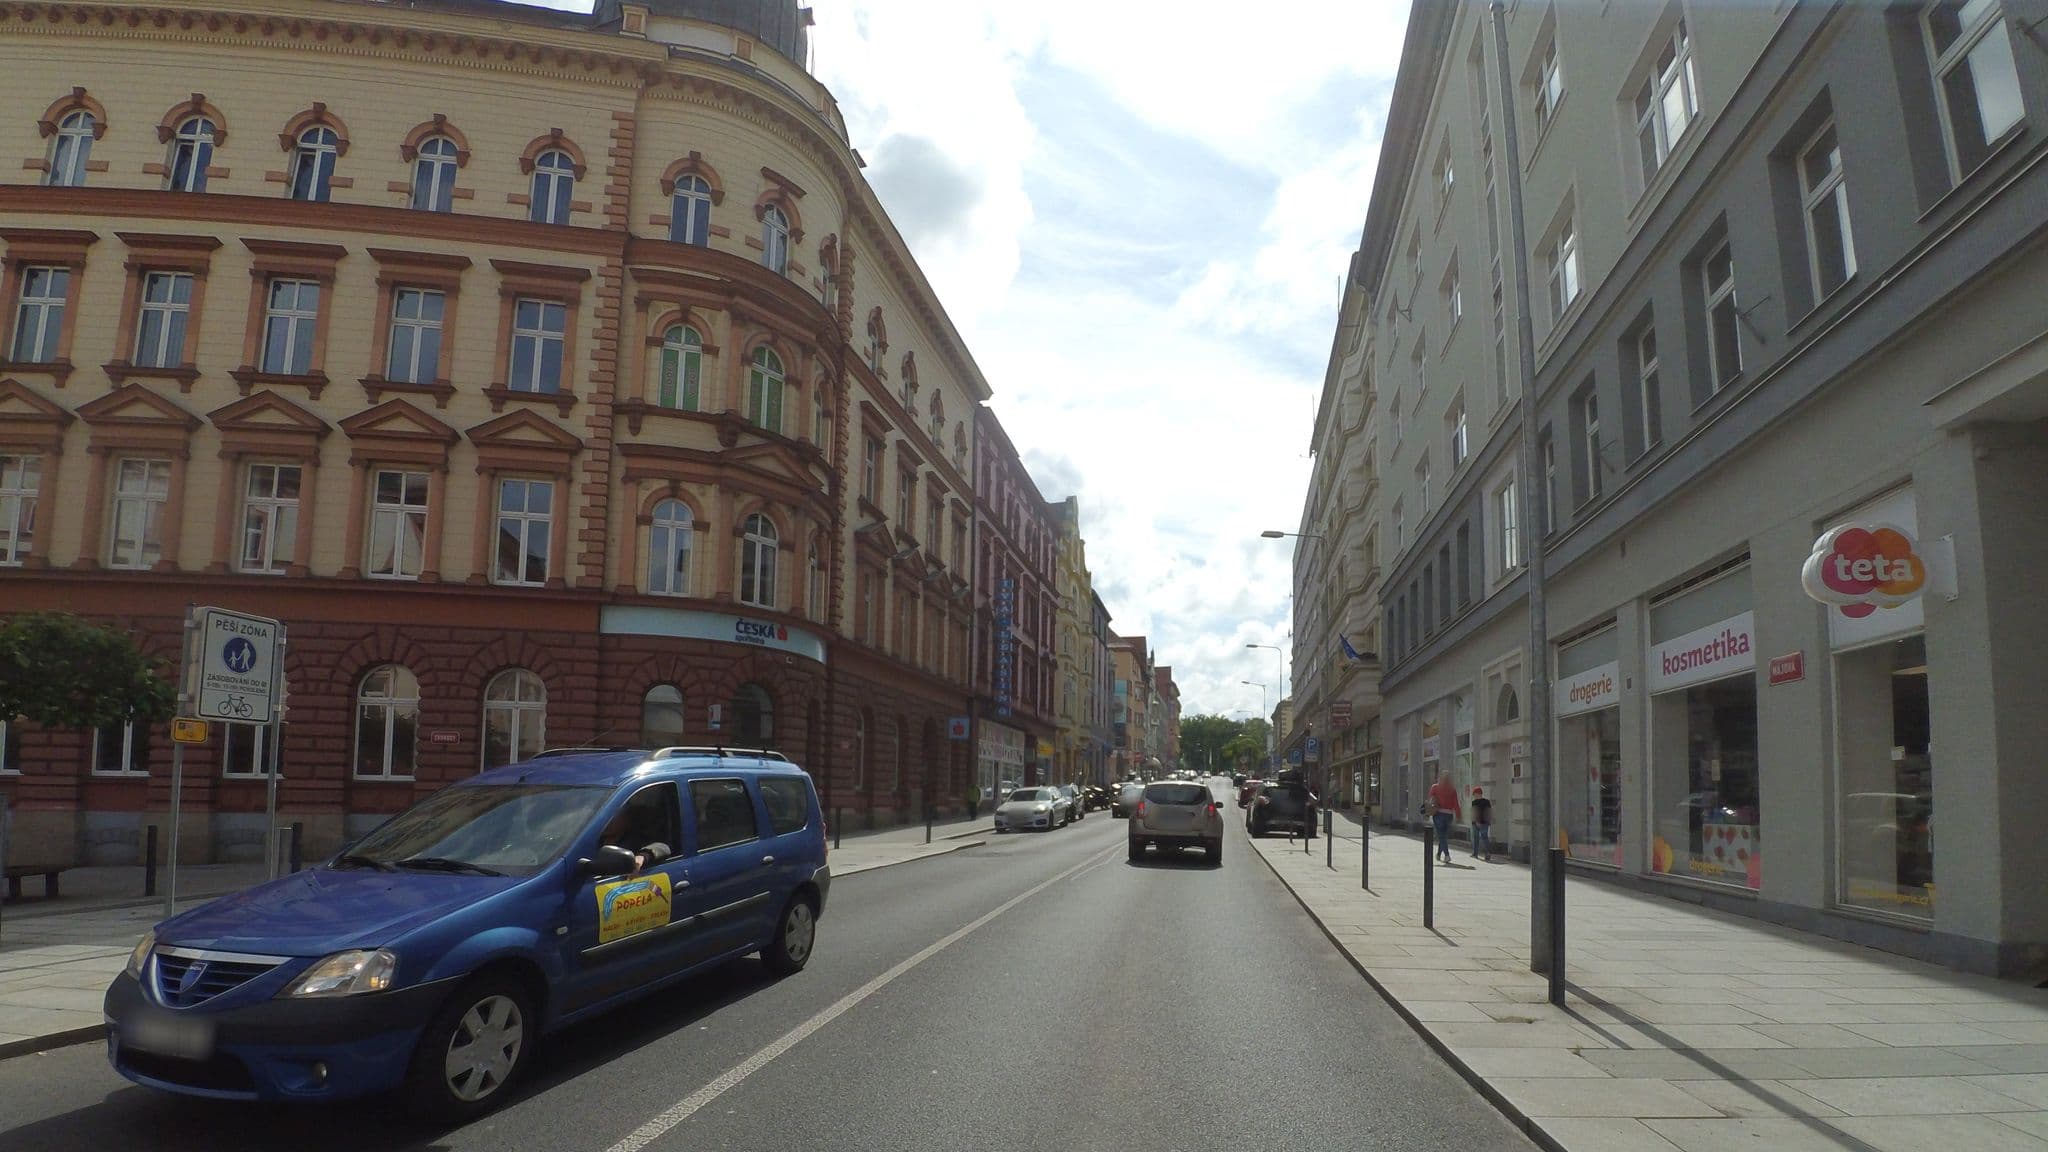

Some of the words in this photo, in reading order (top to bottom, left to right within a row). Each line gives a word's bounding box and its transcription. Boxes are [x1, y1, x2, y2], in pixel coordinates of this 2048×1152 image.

[1834, 554, 1914, 582] teta
[215, 619, 239, 632] PĚŠÍ
[240, 624, 268, 638] ZÓNA
[735, 617, 776, 639] ČESKÁ
[1662, 629, 1750, 676] kosmetika
[1569, 673, 1612, 704] drogerie
[615, 893, 653, 912] POPELA
